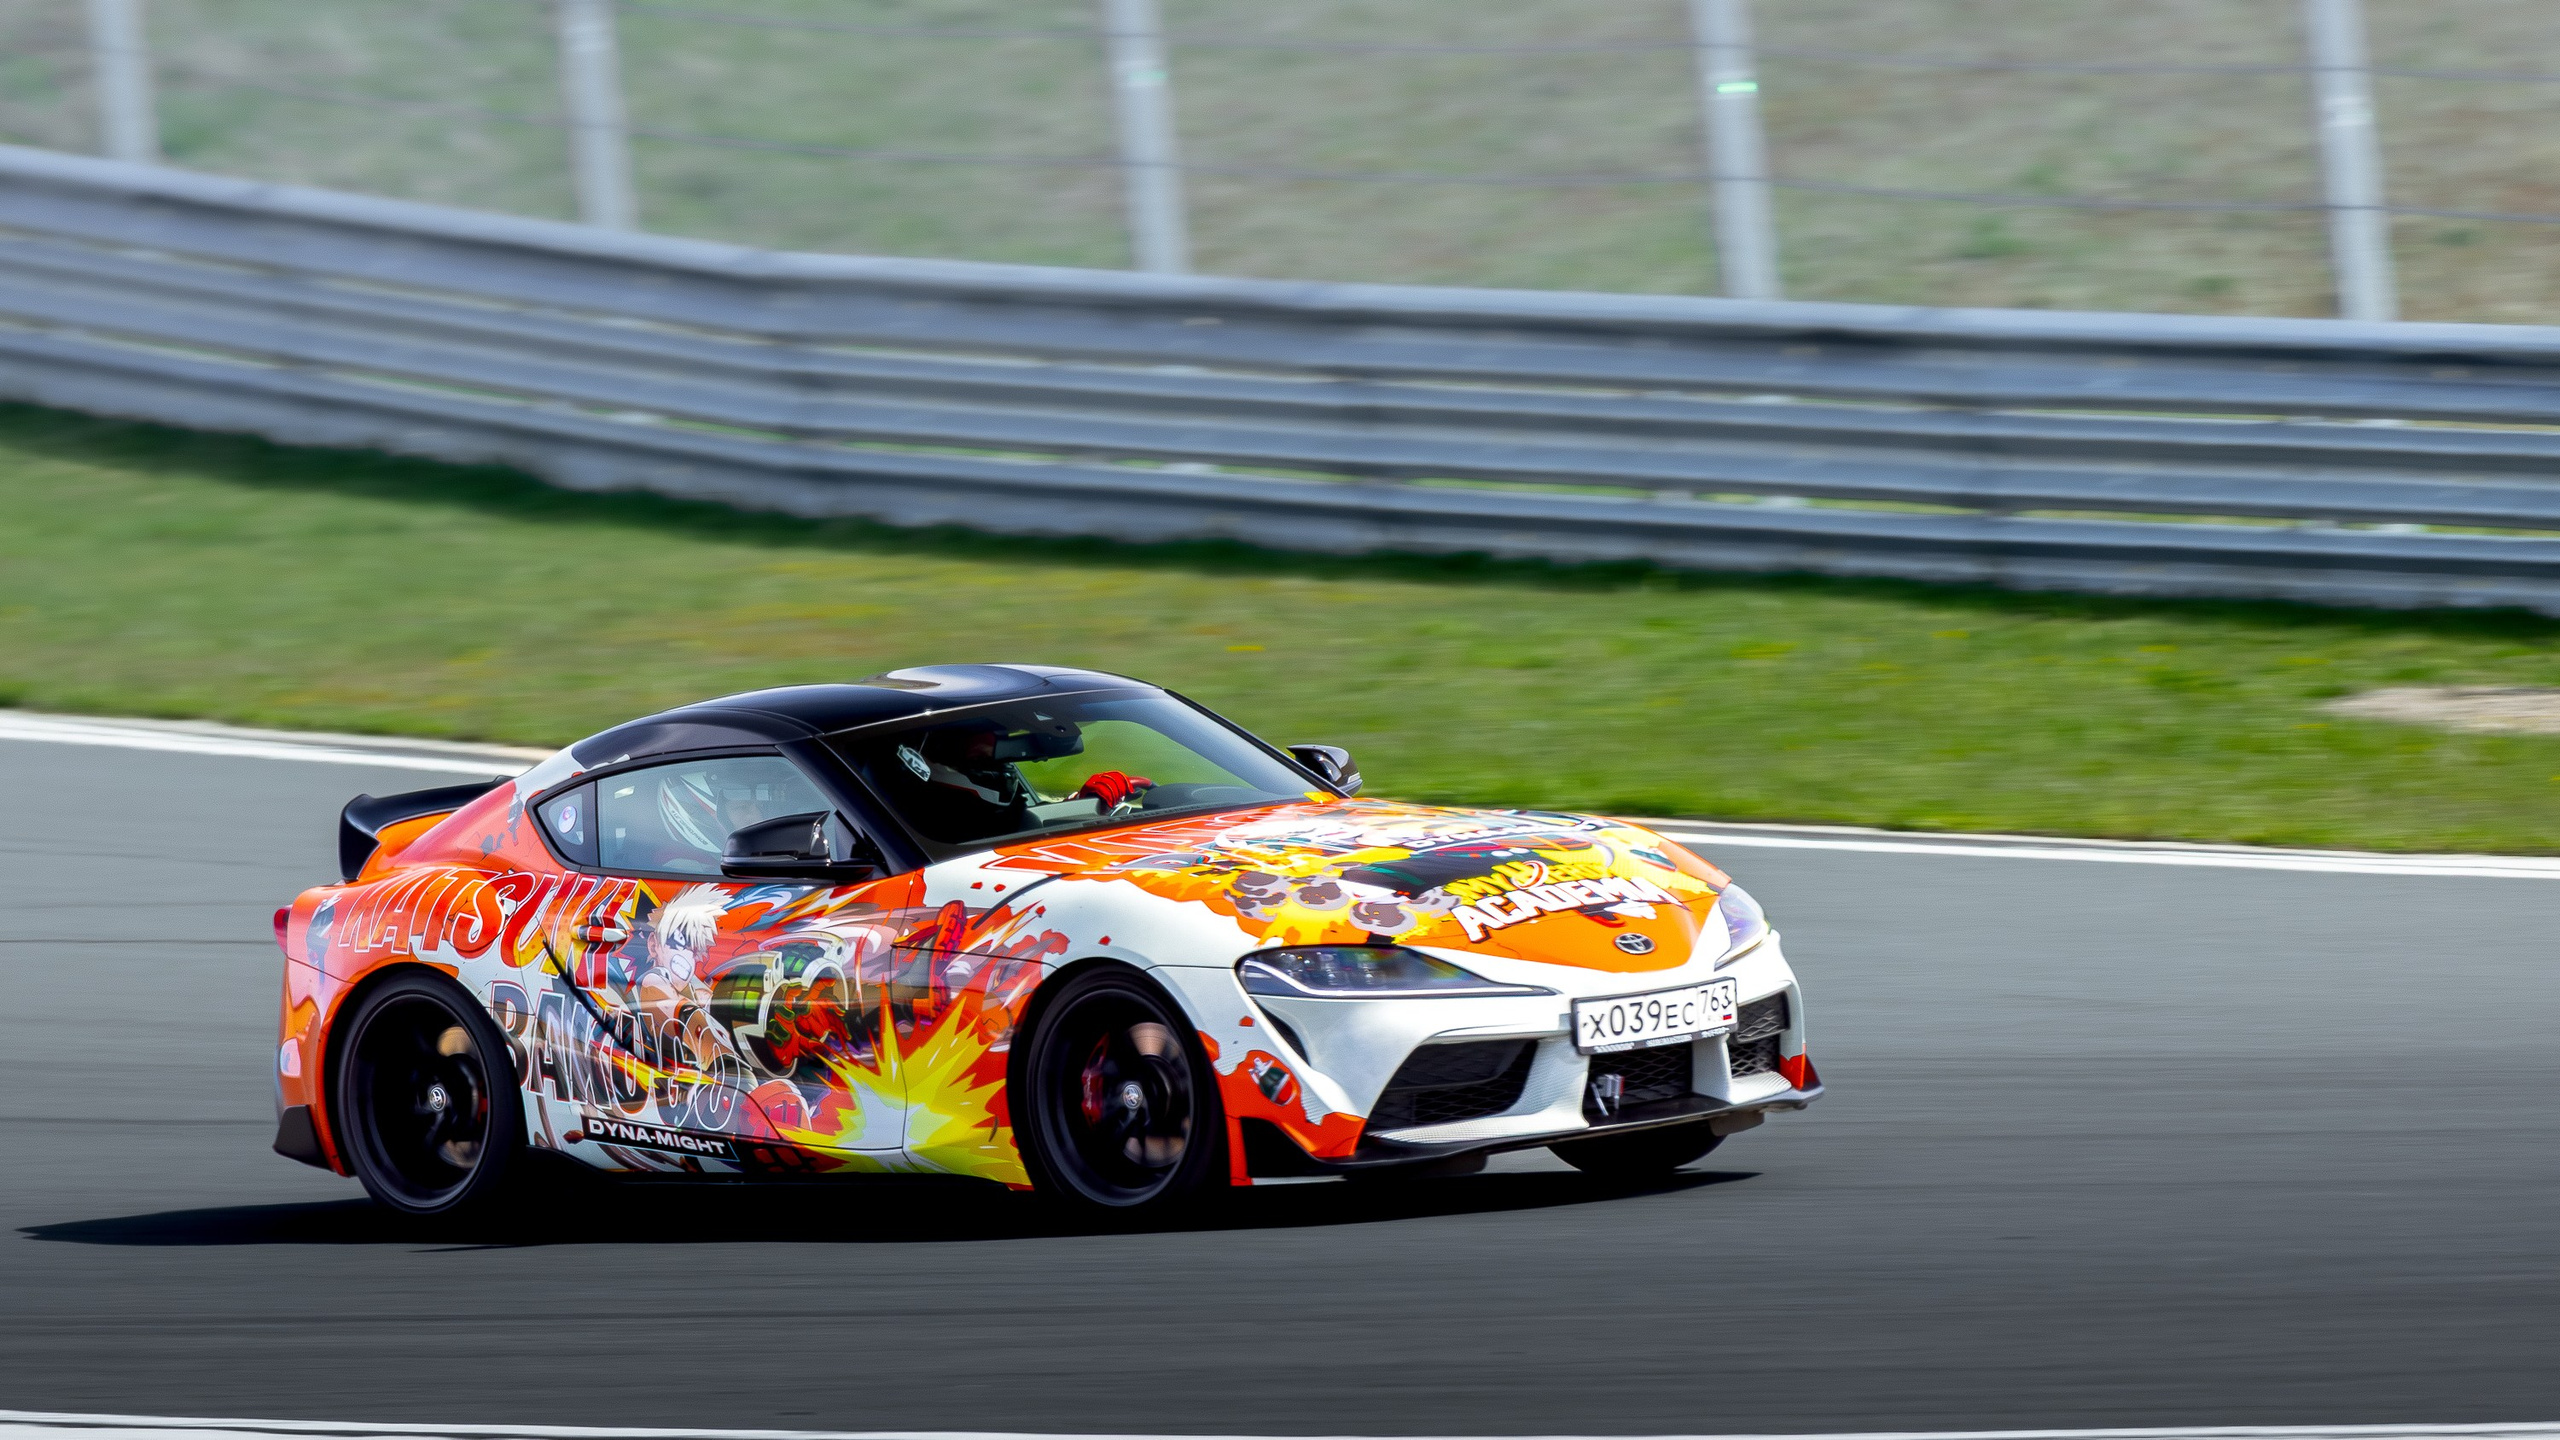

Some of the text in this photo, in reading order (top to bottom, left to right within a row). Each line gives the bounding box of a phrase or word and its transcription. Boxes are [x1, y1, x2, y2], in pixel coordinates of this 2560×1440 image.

[1444, 873, 1519, 900] MY
[1700, 985, 1732, 1014] 763
[588, 1118, 725, 1155] DYNA-MIGHT
